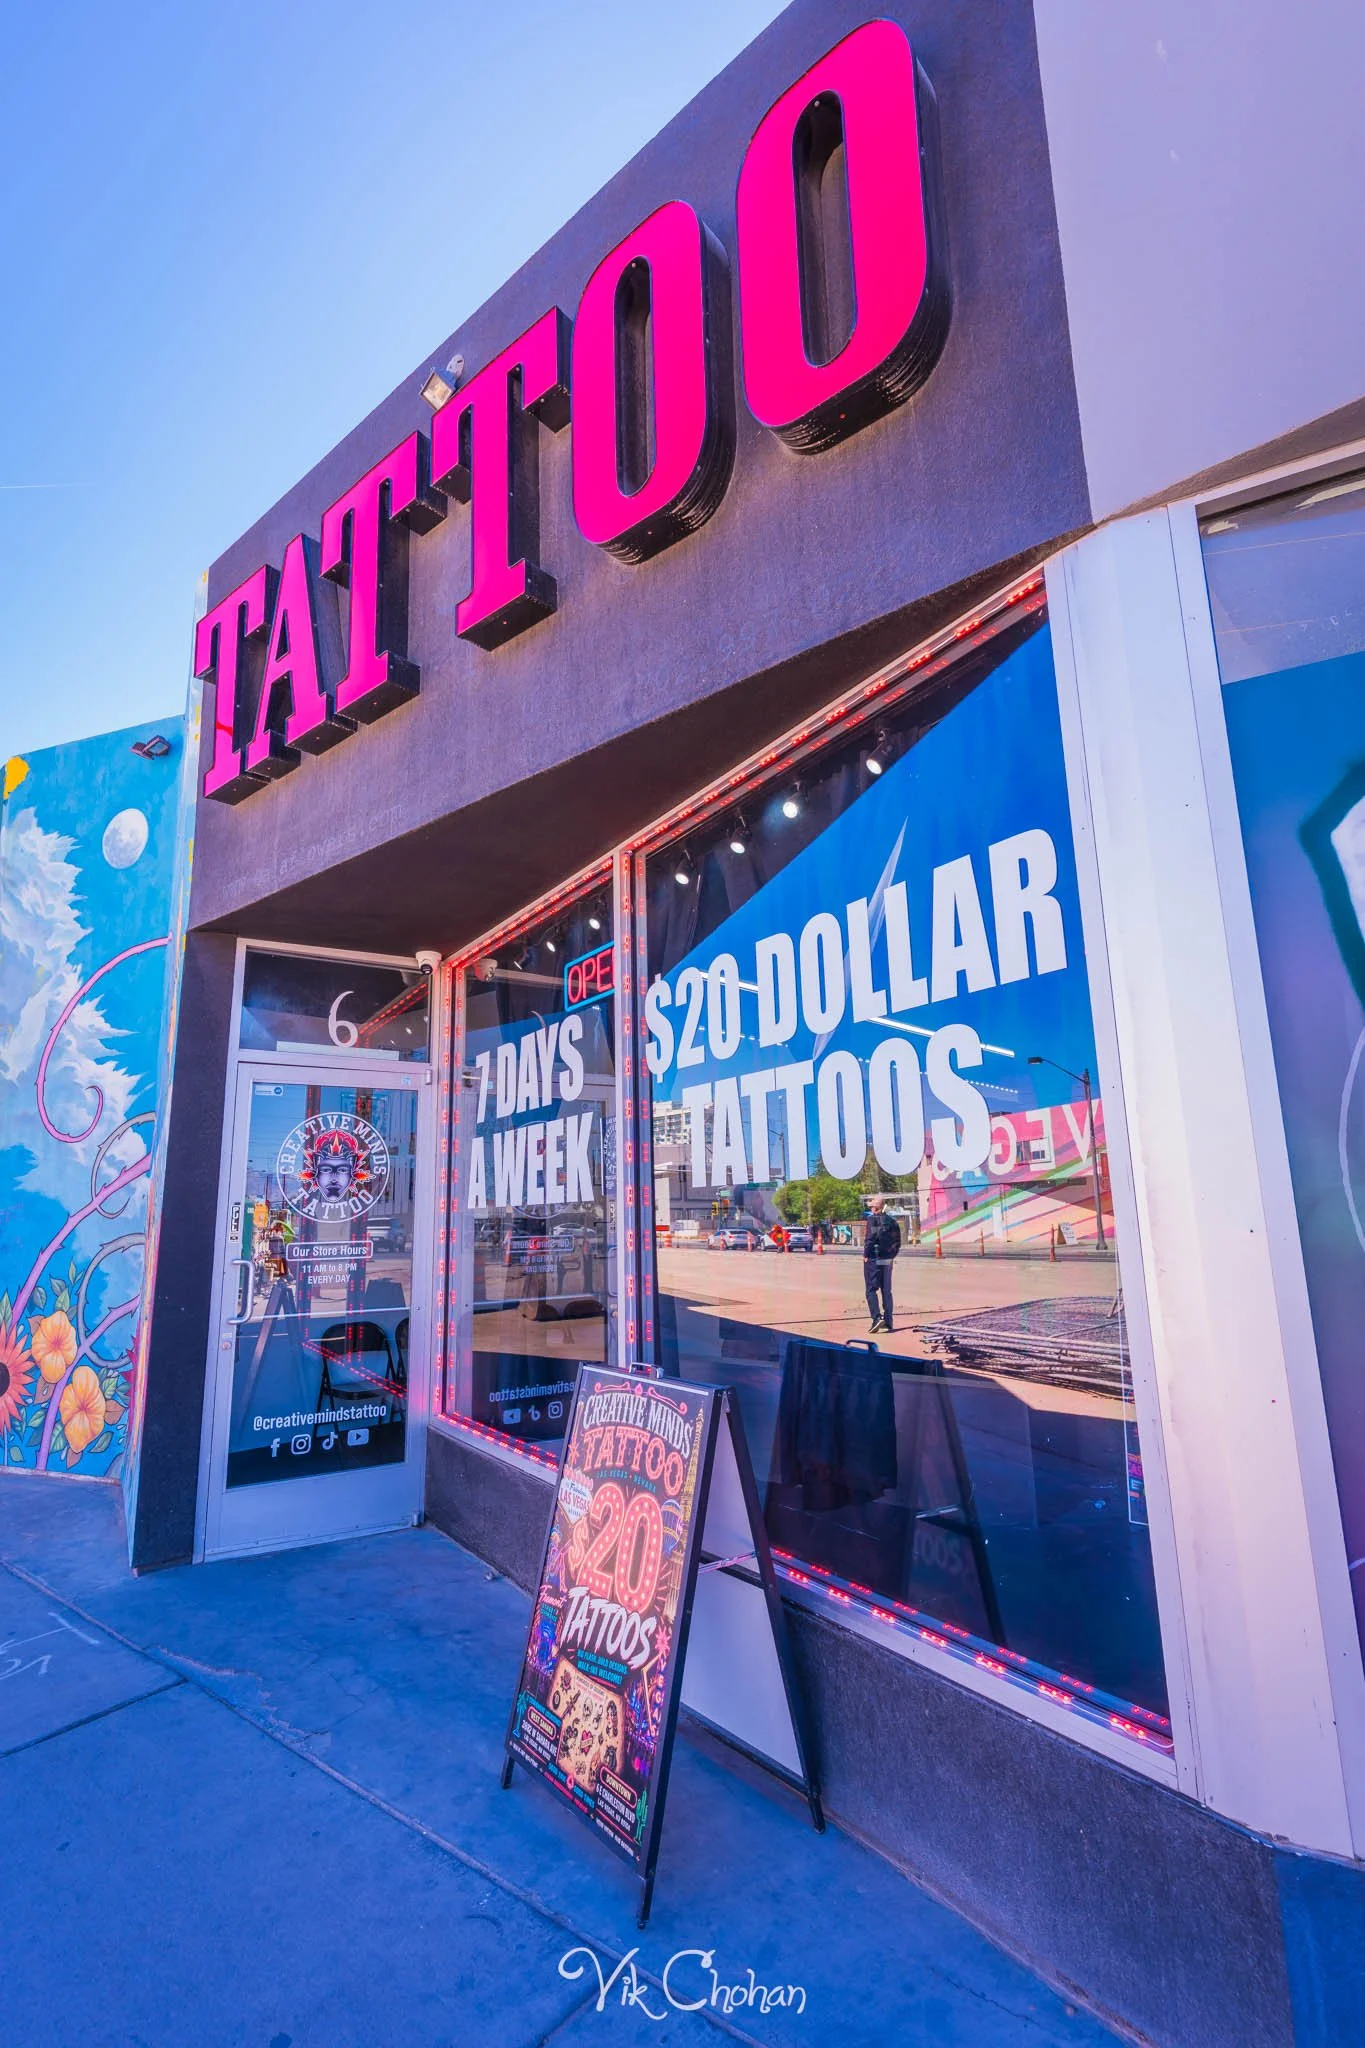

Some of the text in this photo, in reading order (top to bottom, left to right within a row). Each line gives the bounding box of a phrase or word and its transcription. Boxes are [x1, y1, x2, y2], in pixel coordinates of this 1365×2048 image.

[194, 17, 940, 803] TATTOO
[644, 829, 1068, 1083] $20 DOLLAR
[327, 990, 358, 1049] 6
[475, 1014, 585, 1124] 7 DAYS
[682, 1022, 992, 1189] TATTOOS
[280, 1115, 387, 1175] CREATIVE MINDS
[468, 1136, 487, 1208] A
[493, 1112, 595, 1208] WEEK
[291, 1188, 374, 1219] TATTOO
[292, 1243, 367, 1257] Our Store Hours
[302, 1265, 310, 1273] 11
[314, 1264, 326, 1273] AM
[328, 1264, 336, 1272] to
[345, 1262, 357, 1271] PM
[308, 1273, 351, 1285] EVERY DAY
[253, 1405, 387, 1431] @creativemindstattoo
[582, 1391, 694, 1459] CREATIVE MINDS
[581, 1425, 684, 1497] TATTOO
[560, 1487, 571, 1505] LAS
[559, 1586, 657, 1671] TATTOOS
[606, 1774, 632, 1801] DOWNTOWN
